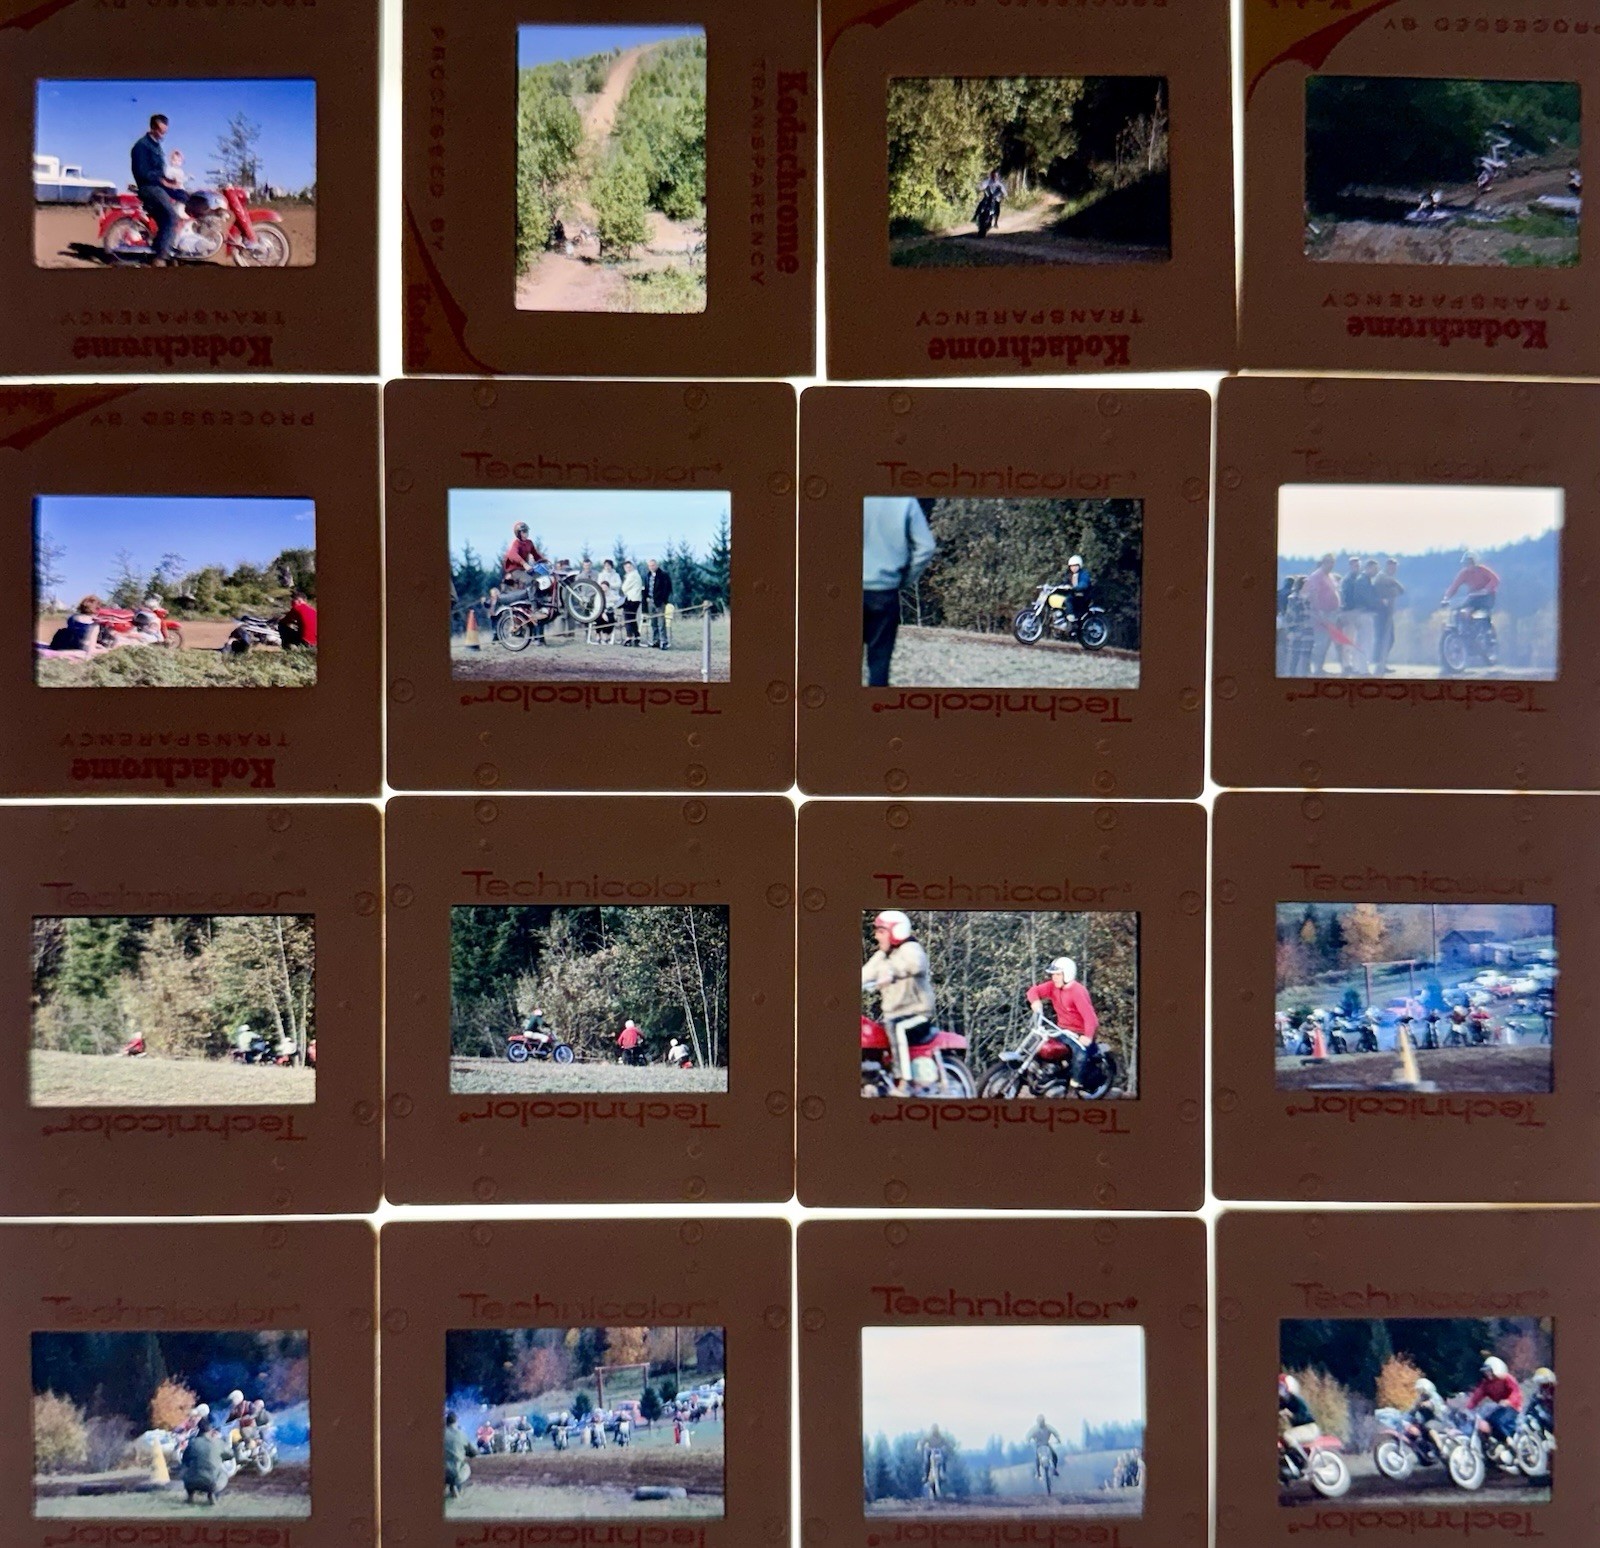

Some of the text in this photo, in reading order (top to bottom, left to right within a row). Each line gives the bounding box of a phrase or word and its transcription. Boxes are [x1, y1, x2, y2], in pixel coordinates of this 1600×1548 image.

[751, 58, 767, 287] TRANSPARENCY
[777, 70, 809, 276] Kodachrome
[914, 308, 1146, 328] TRANSPARENCY
[1321, 291, 1571, 313] TRANSPARENCY
[1346, 315, 1549, 350] Kodachrome
[71, 335, 274, 367] Kodachrome
[926, 333, 1131, 368] Kodachrome
[471, 684, 723, 715] Technicolor
[882, 692, 1133, 723] Technicolor
[59, 732, 289, 748] TRANSPARENCY
[71, 756, 276, 789] Kodachrome
[469, 1099, 722, 1129] Technicolor
[880, 1102, 1131, 1134] Technicolor
[871, 1285, 1128, 1319] Technicolor
